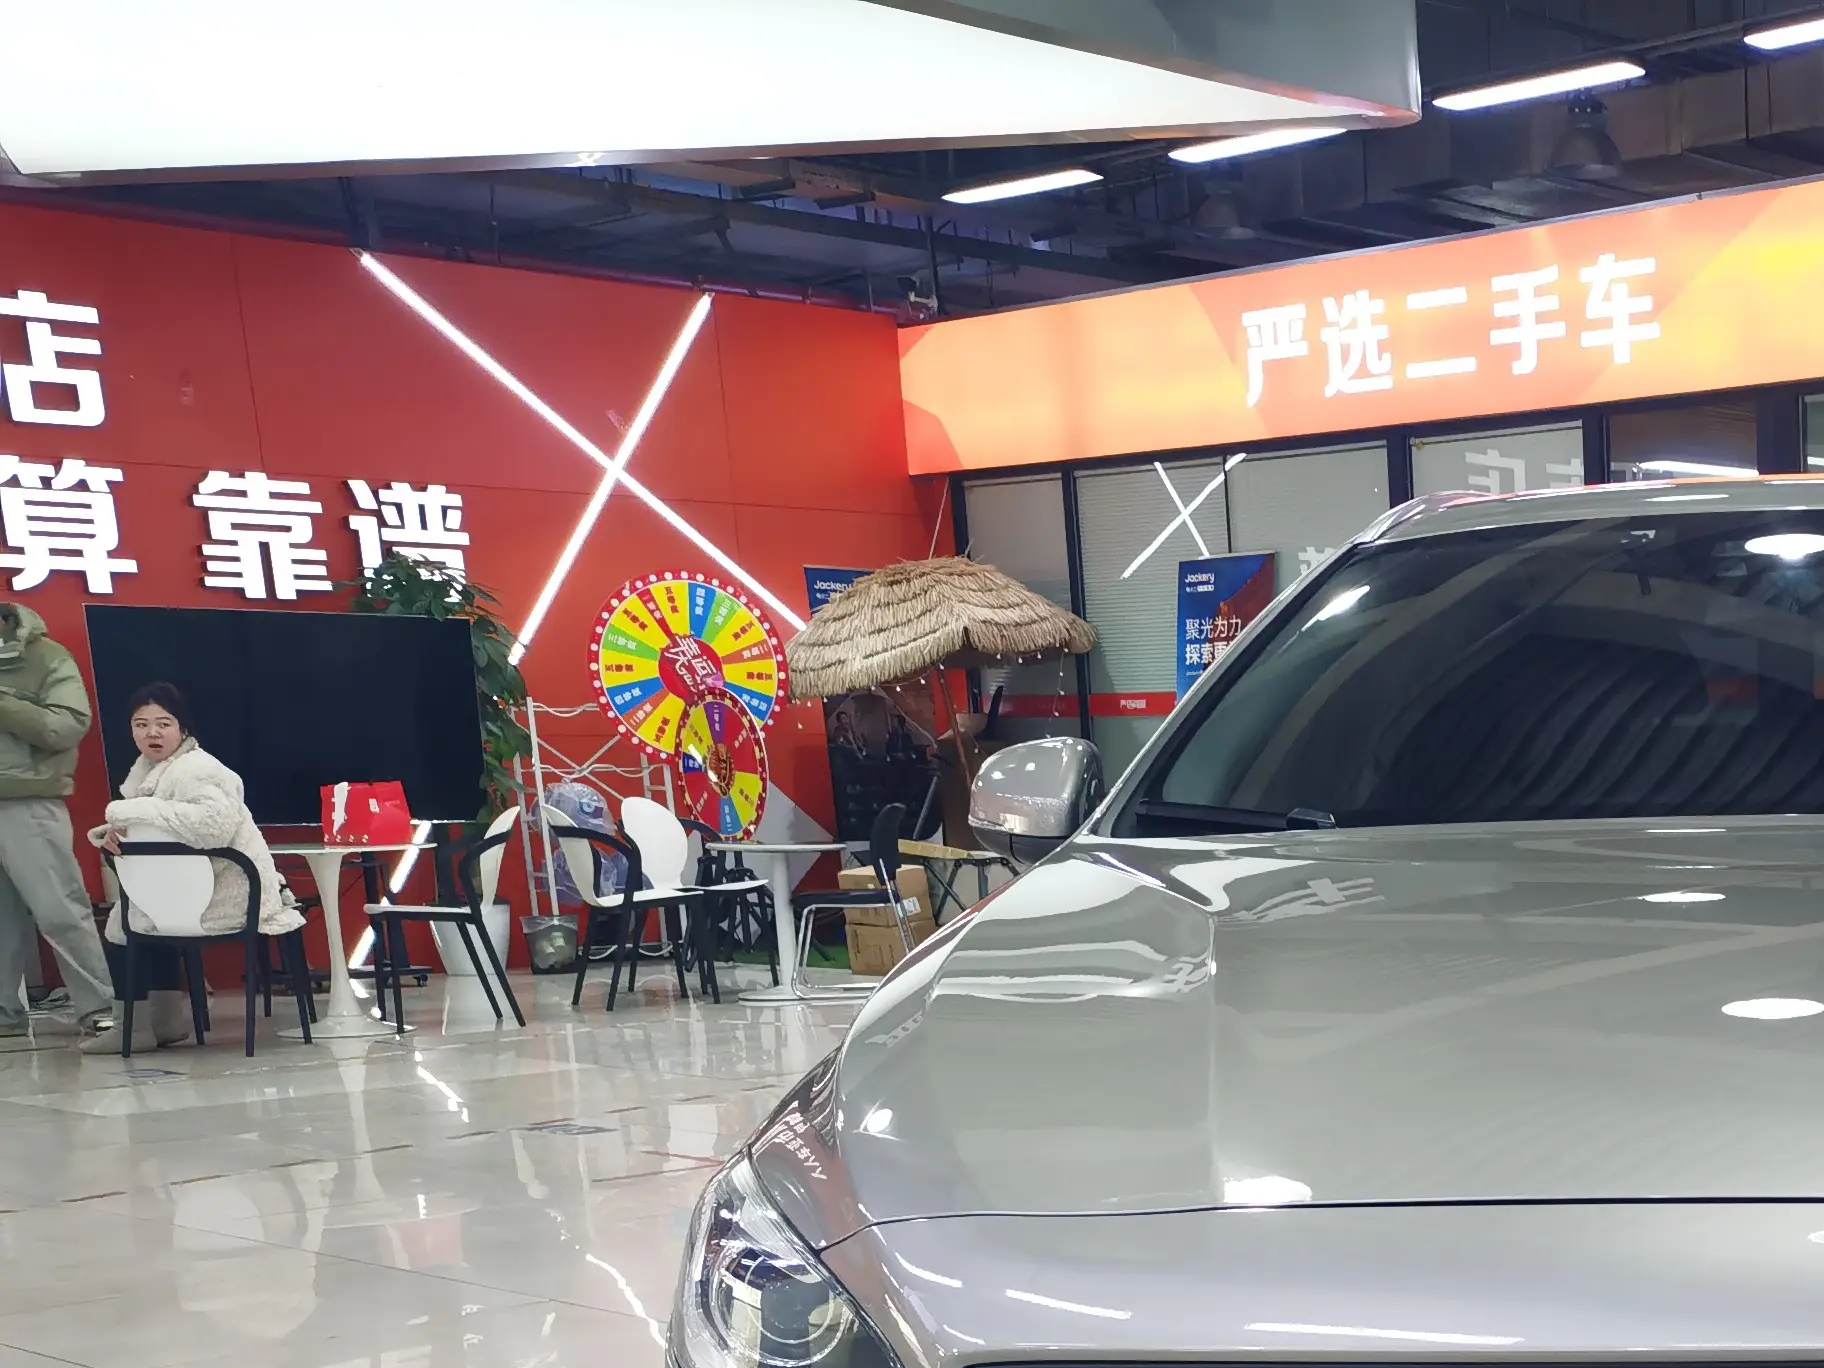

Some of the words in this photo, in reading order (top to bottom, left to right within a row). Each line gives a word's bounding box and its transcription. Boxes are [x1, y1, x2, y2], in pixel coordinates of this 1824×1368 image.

[0, 290, 105, 427] 店
[1241, 253, 1662, 408] 严选二手车
[1185, 614, 1242, 640] 聚光为力
[1185, 641, 1234, 665] 探索更
